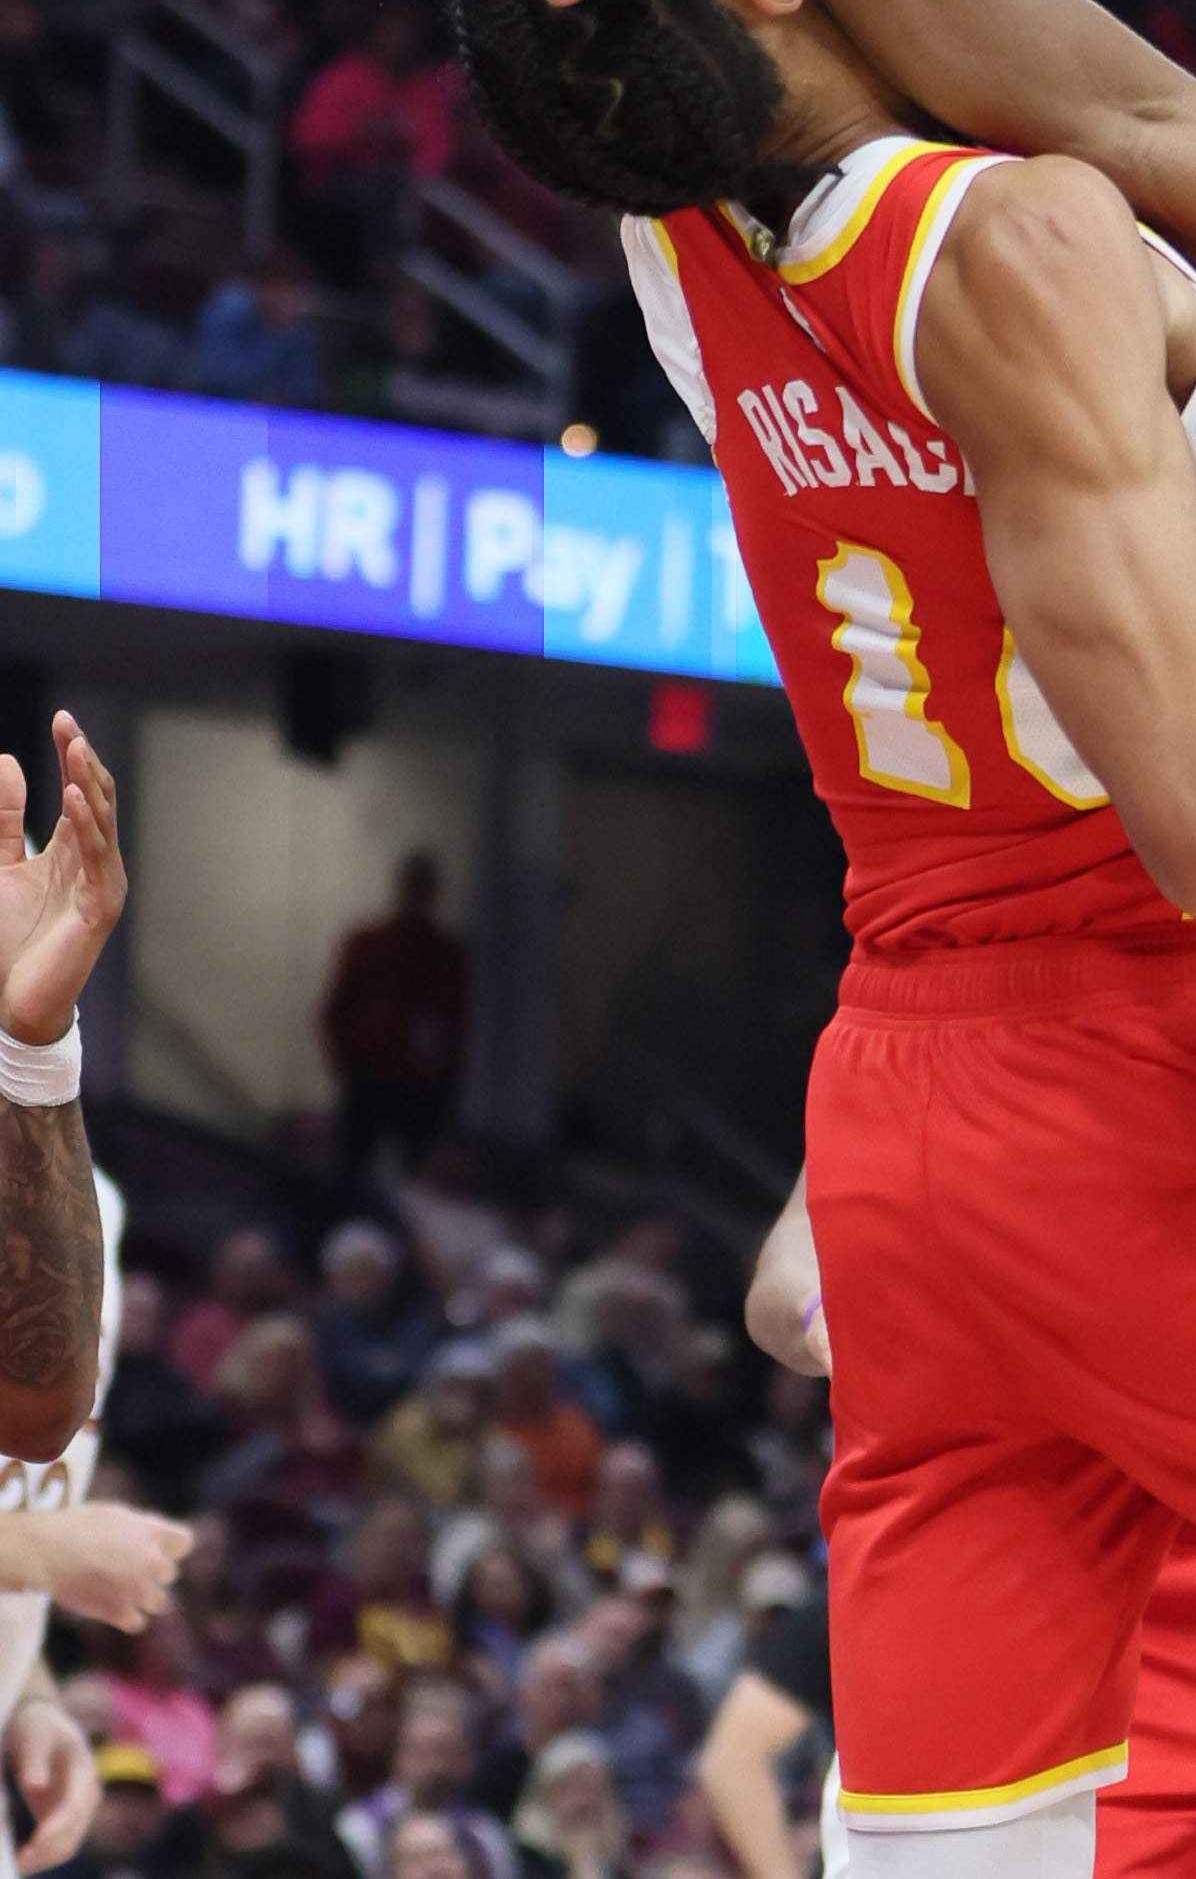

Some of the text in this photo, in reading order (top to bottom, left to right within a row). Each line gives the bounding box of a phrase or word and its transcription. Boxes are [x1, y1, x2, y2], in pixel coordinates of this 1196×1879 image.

[737, 377, 977, 498] RISAC
[239, 456, 398, 589] HR
[463, 486, 643, 643] Pay
